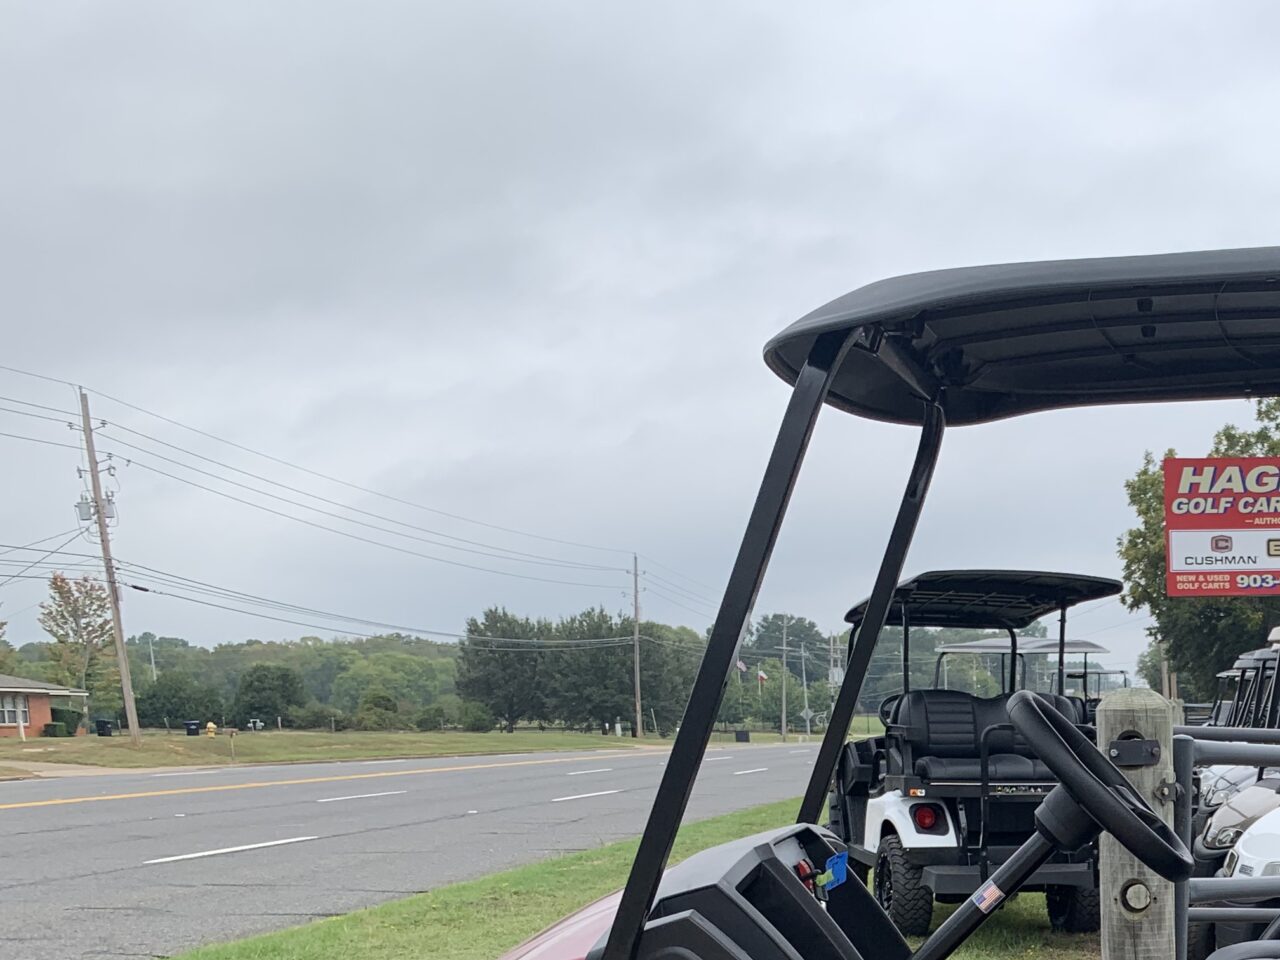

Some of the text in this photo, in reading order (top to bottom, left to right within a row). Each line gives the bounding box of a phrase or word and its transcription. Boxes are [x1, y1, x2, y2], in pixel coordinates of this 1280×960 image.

[1171, 497, 1234, 515] GOLF
[1184, 555, 1257, 566] CUSHMAN
[1176, 574, 1231, 582] NEW & USED
[1177, 582, 1231, 590] GOLF CARTS
